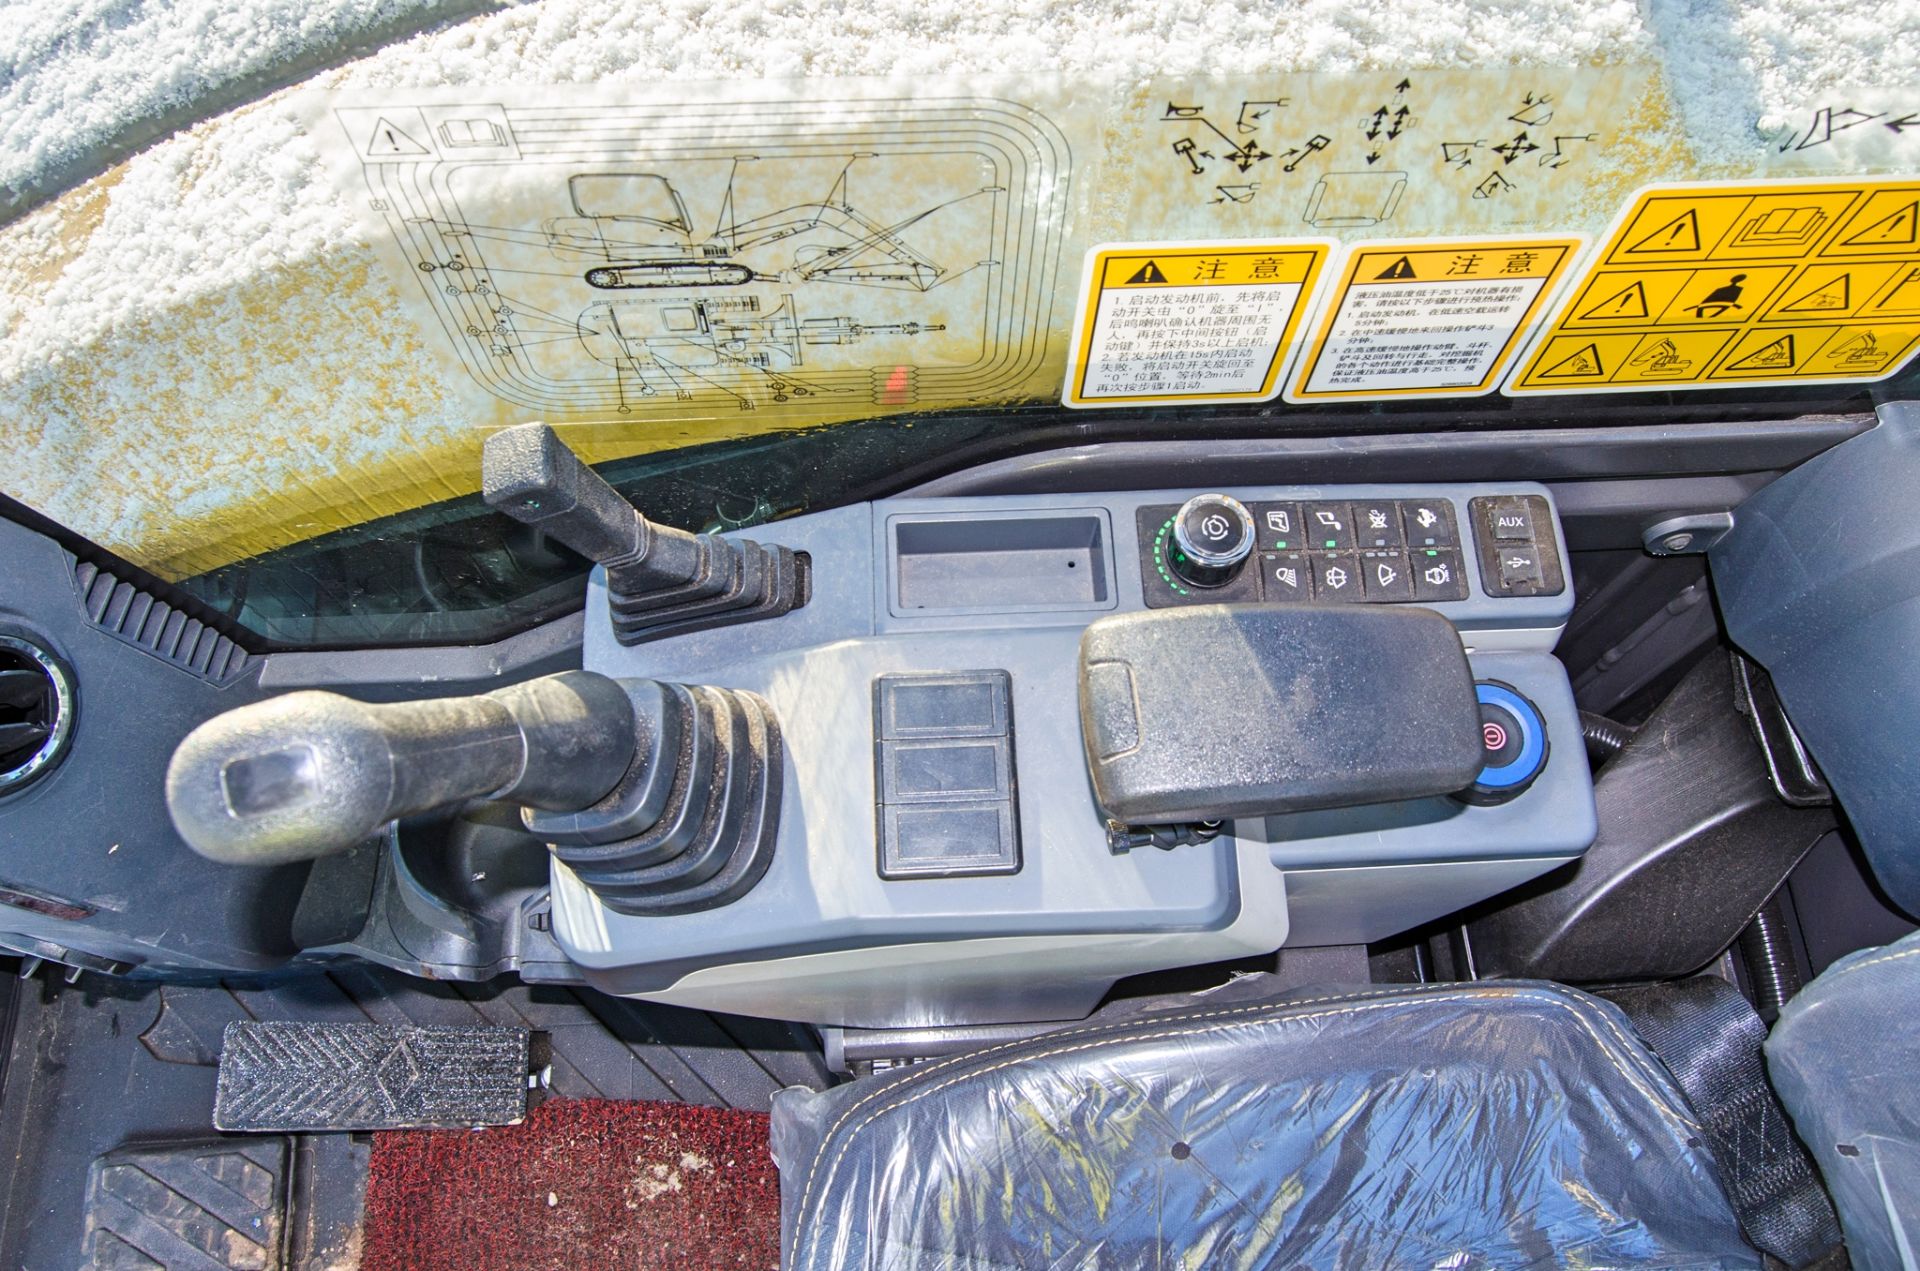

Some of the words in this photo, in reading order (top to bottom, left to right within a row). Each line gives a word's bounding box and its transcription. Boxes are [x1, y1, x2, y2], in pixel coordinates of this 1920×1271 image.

[1108, 314, 1273, 329] 后鸣喇叭确认机器周围无
[1498, 517, 1525, 527] AUX
